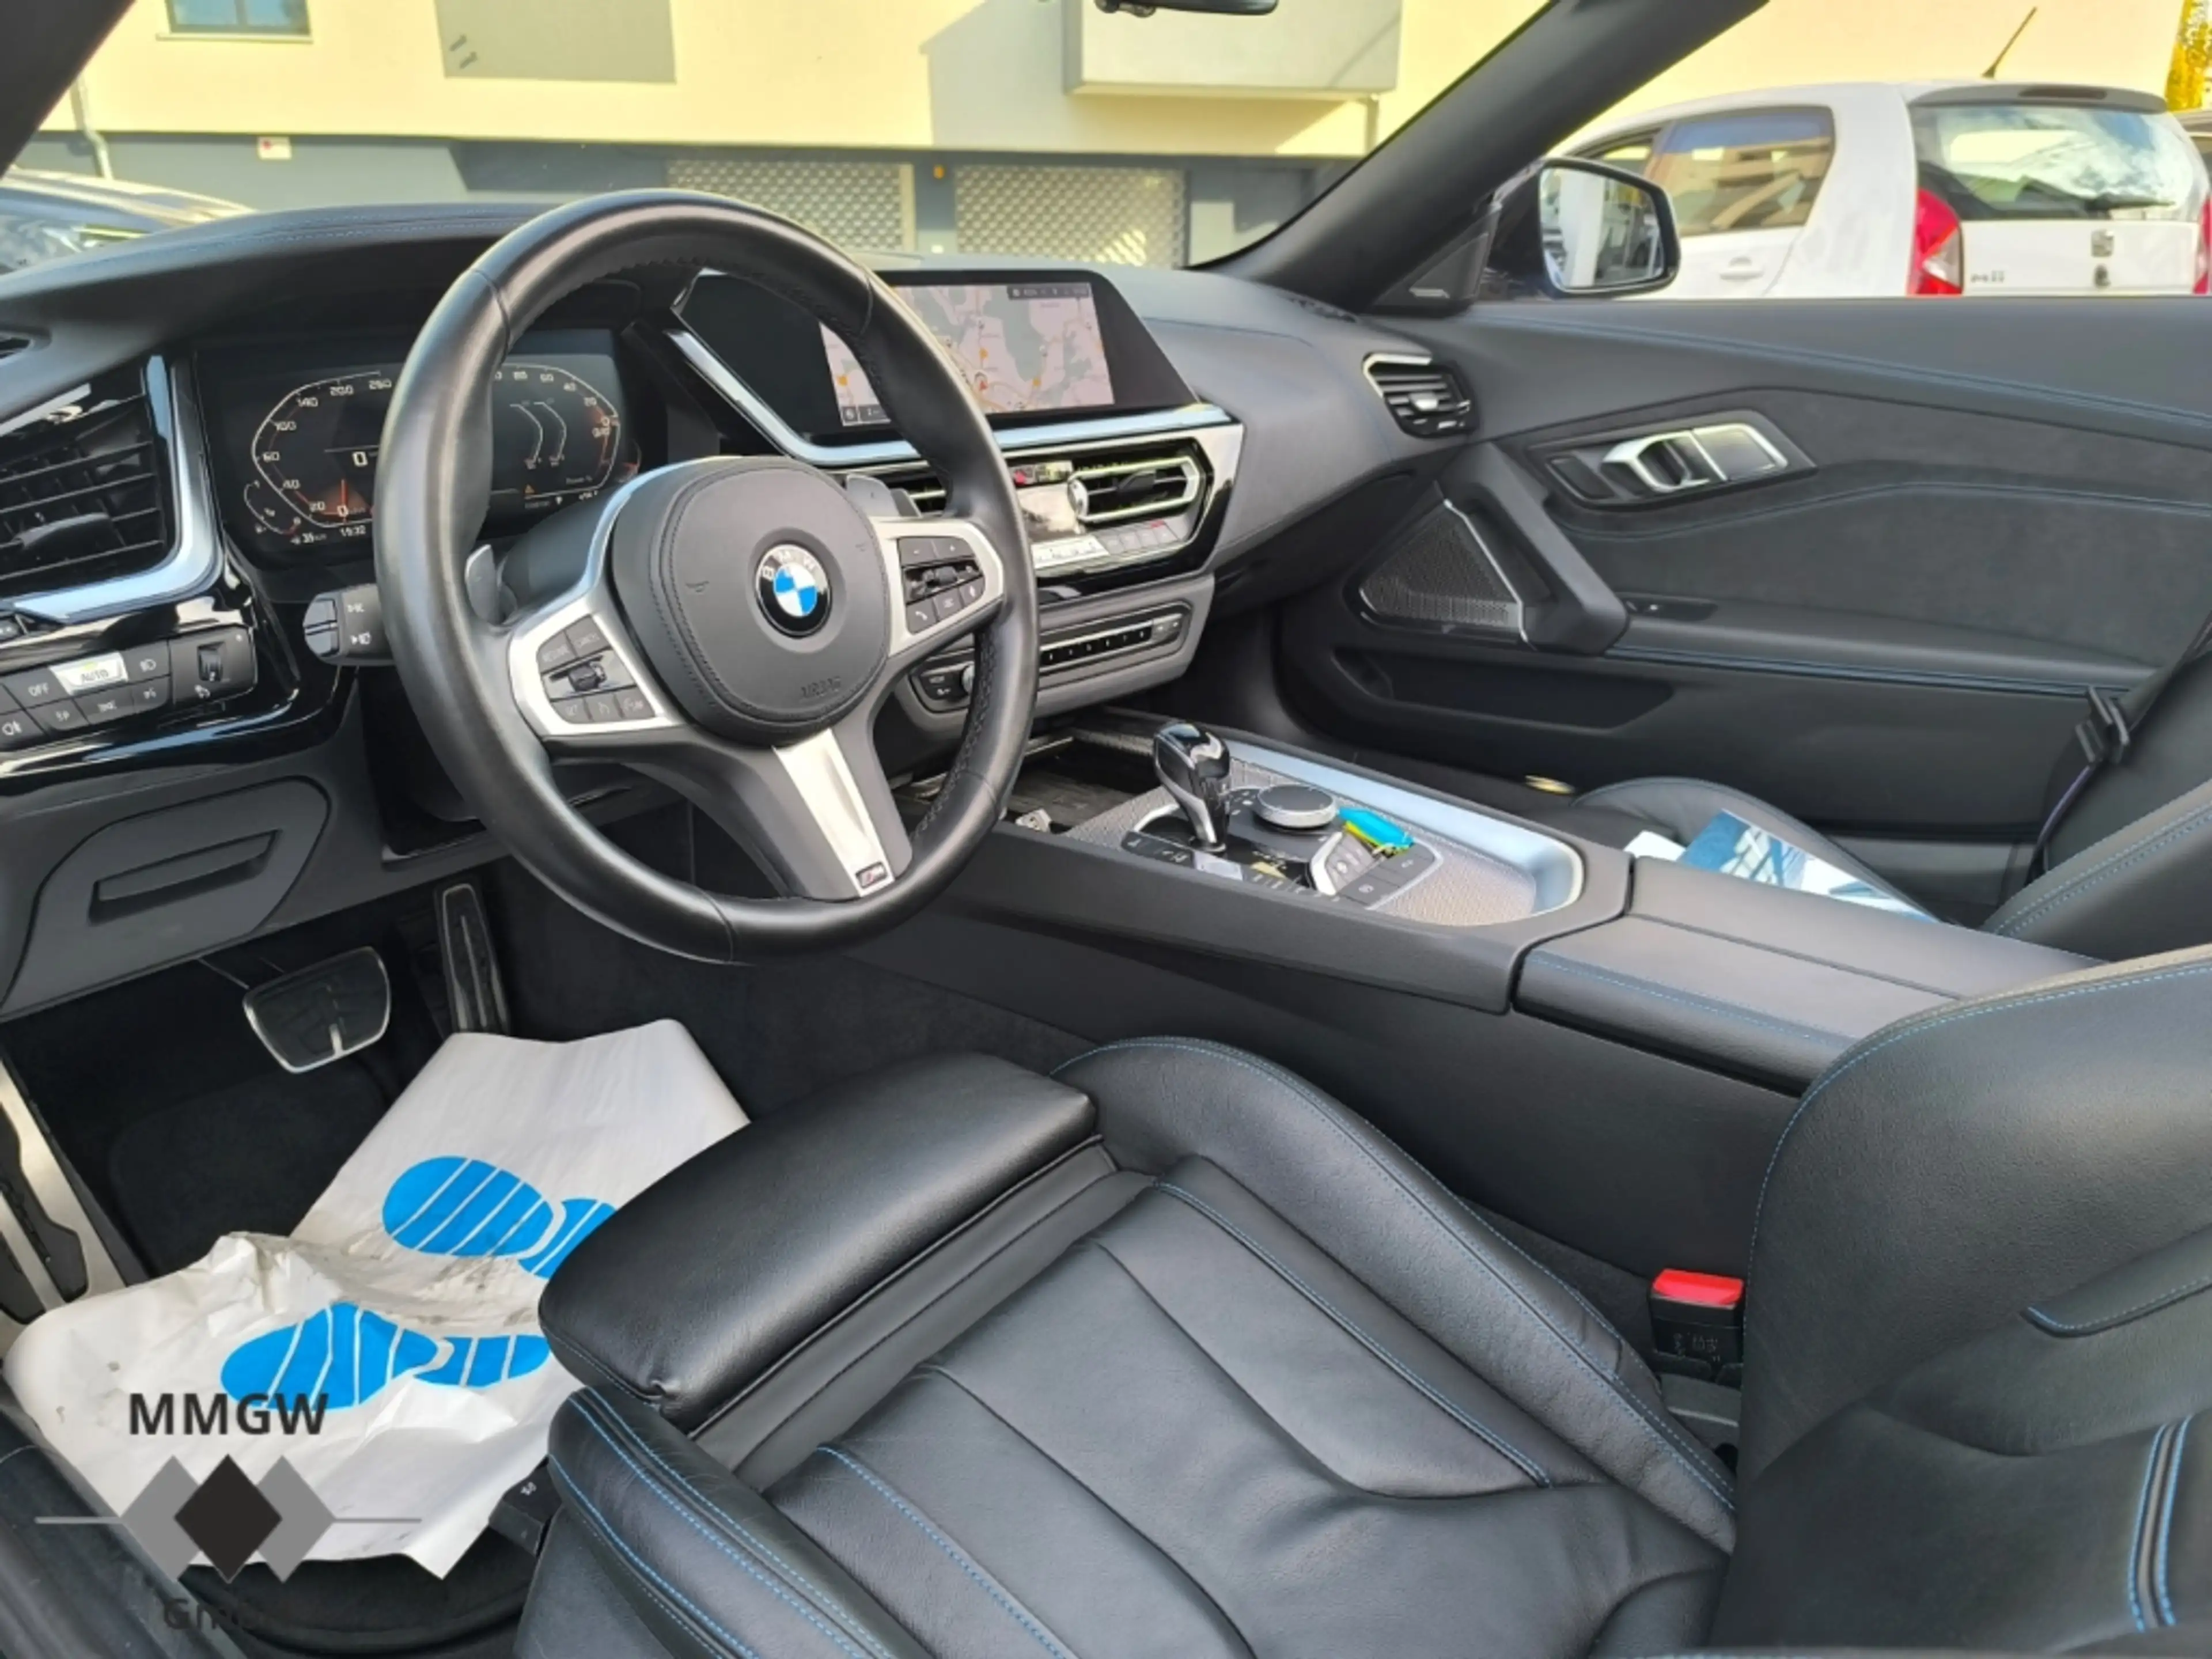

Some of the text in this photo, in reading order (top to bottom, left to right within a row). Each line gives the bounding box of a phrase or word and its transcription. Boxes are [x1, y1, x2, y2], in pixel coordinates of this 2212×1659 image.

[329, 385, 355, 396] 200
[263, 451, 280, 463] 60
[352, 451, 368, 467] 0
[283, 479, 301, 490] 40
[80, 668, 109, 684] AUTO
[28, 682, 50, 697] OFF
